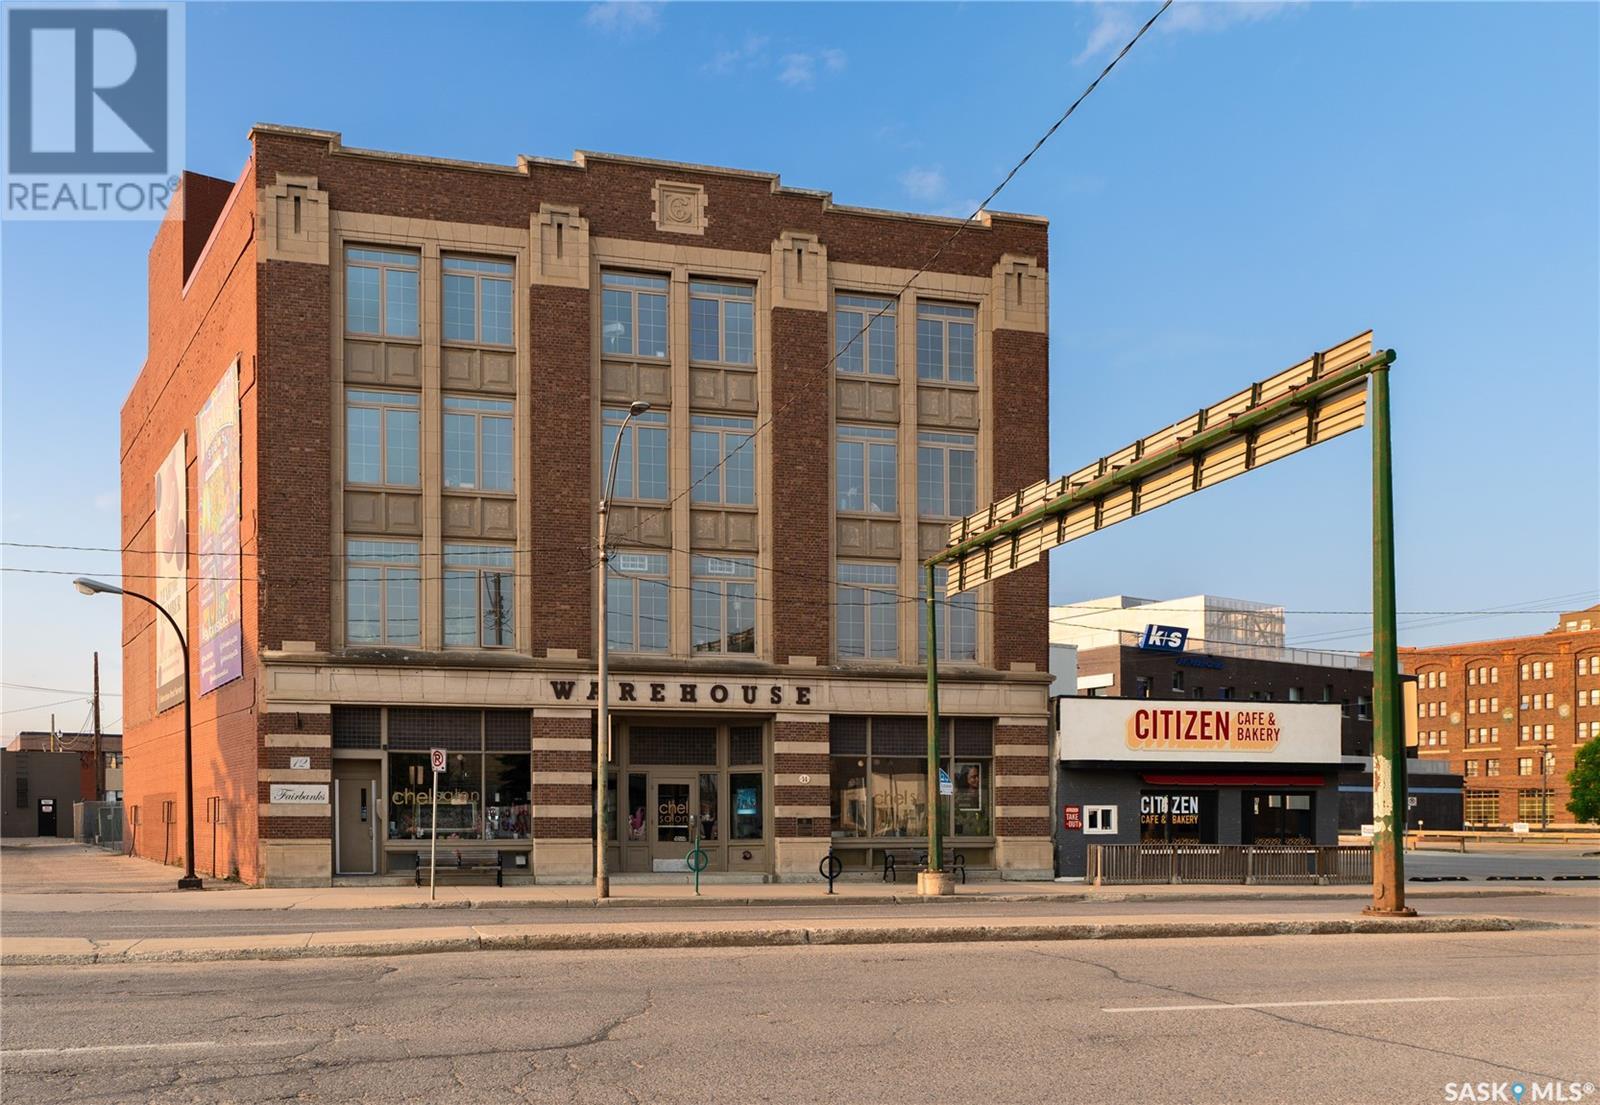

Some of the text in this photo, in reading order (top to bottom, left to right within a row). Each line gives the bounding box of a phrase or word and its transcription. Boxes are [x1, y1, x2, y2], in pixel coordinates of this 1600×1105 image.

[1135, 709, 1230, 740] CITIZEN
[1237, 711, 1276, 726] CAFE &
[1237, 727, 1280, 742] BAKERY
[292, 758, 308, 768] 12
[273, 786, 326, 801] Fairbanks
[392, 787, 432, 805] chel
[874, 789, 907, 806] chel
[659, 799, 689, 814] chel
[659, 814, 689, 824] salon
[1141, 815, 1198, 825] CAFE & BAKERY
